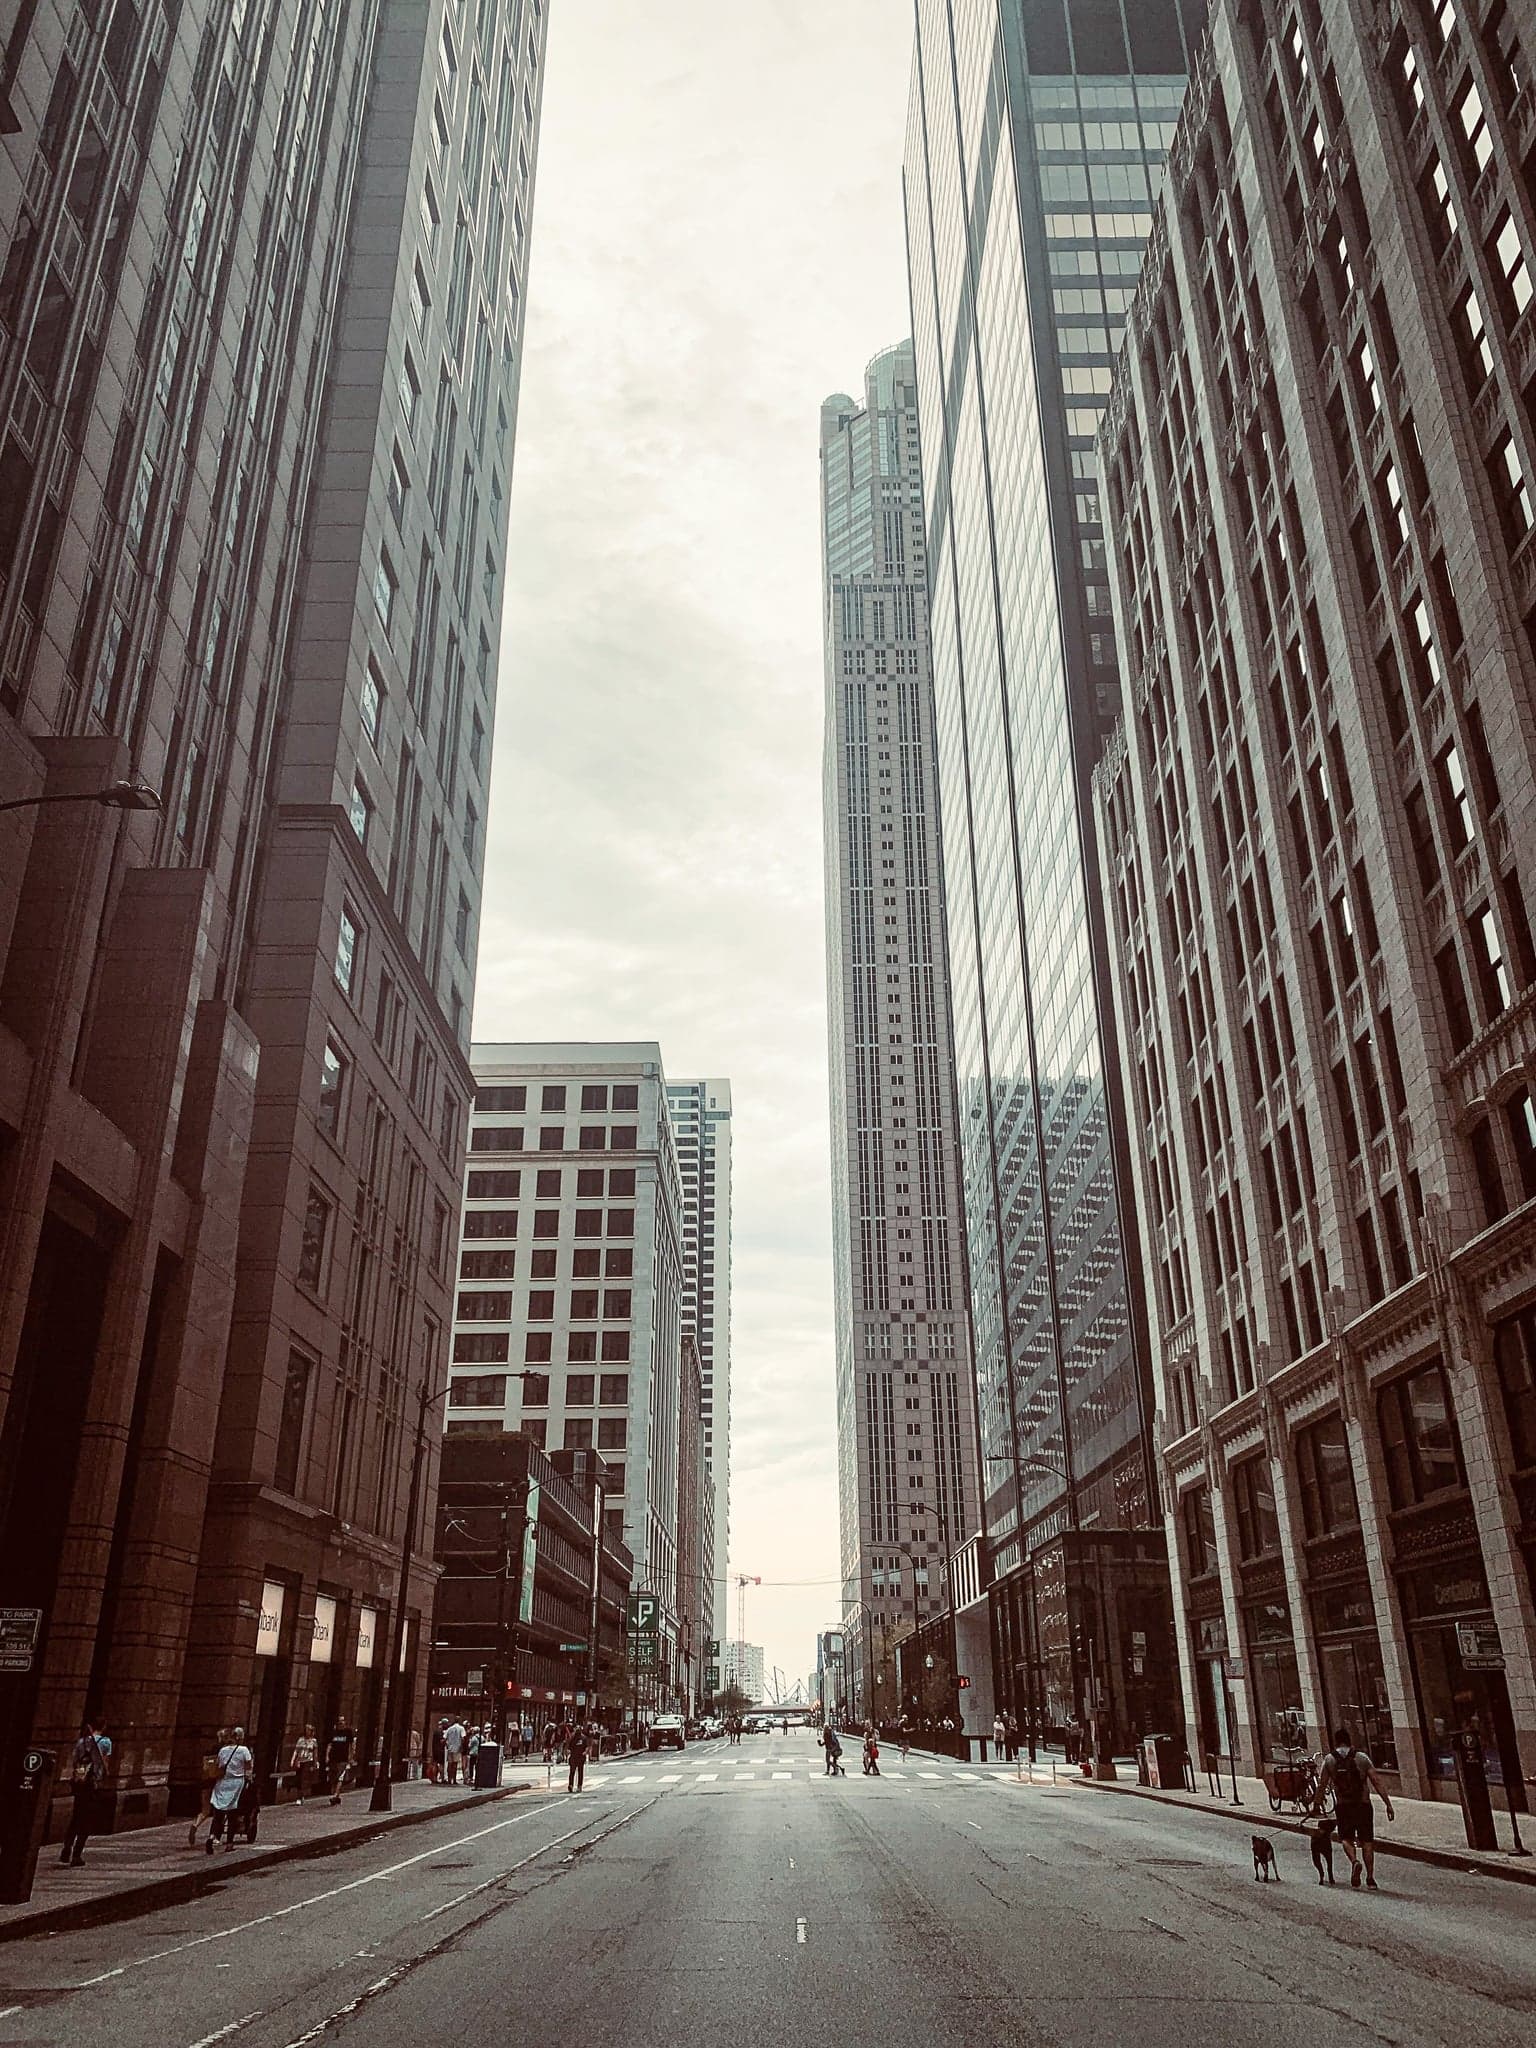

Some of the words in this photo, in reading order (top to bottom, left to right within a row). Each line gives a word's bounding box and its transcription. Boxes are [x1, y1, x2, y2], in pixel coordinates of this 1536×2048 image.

[628, 1646, 654, 1656] SELF
[628, 1658, 654, 1666] PARK
[29, 1755, 38, 1769] P
